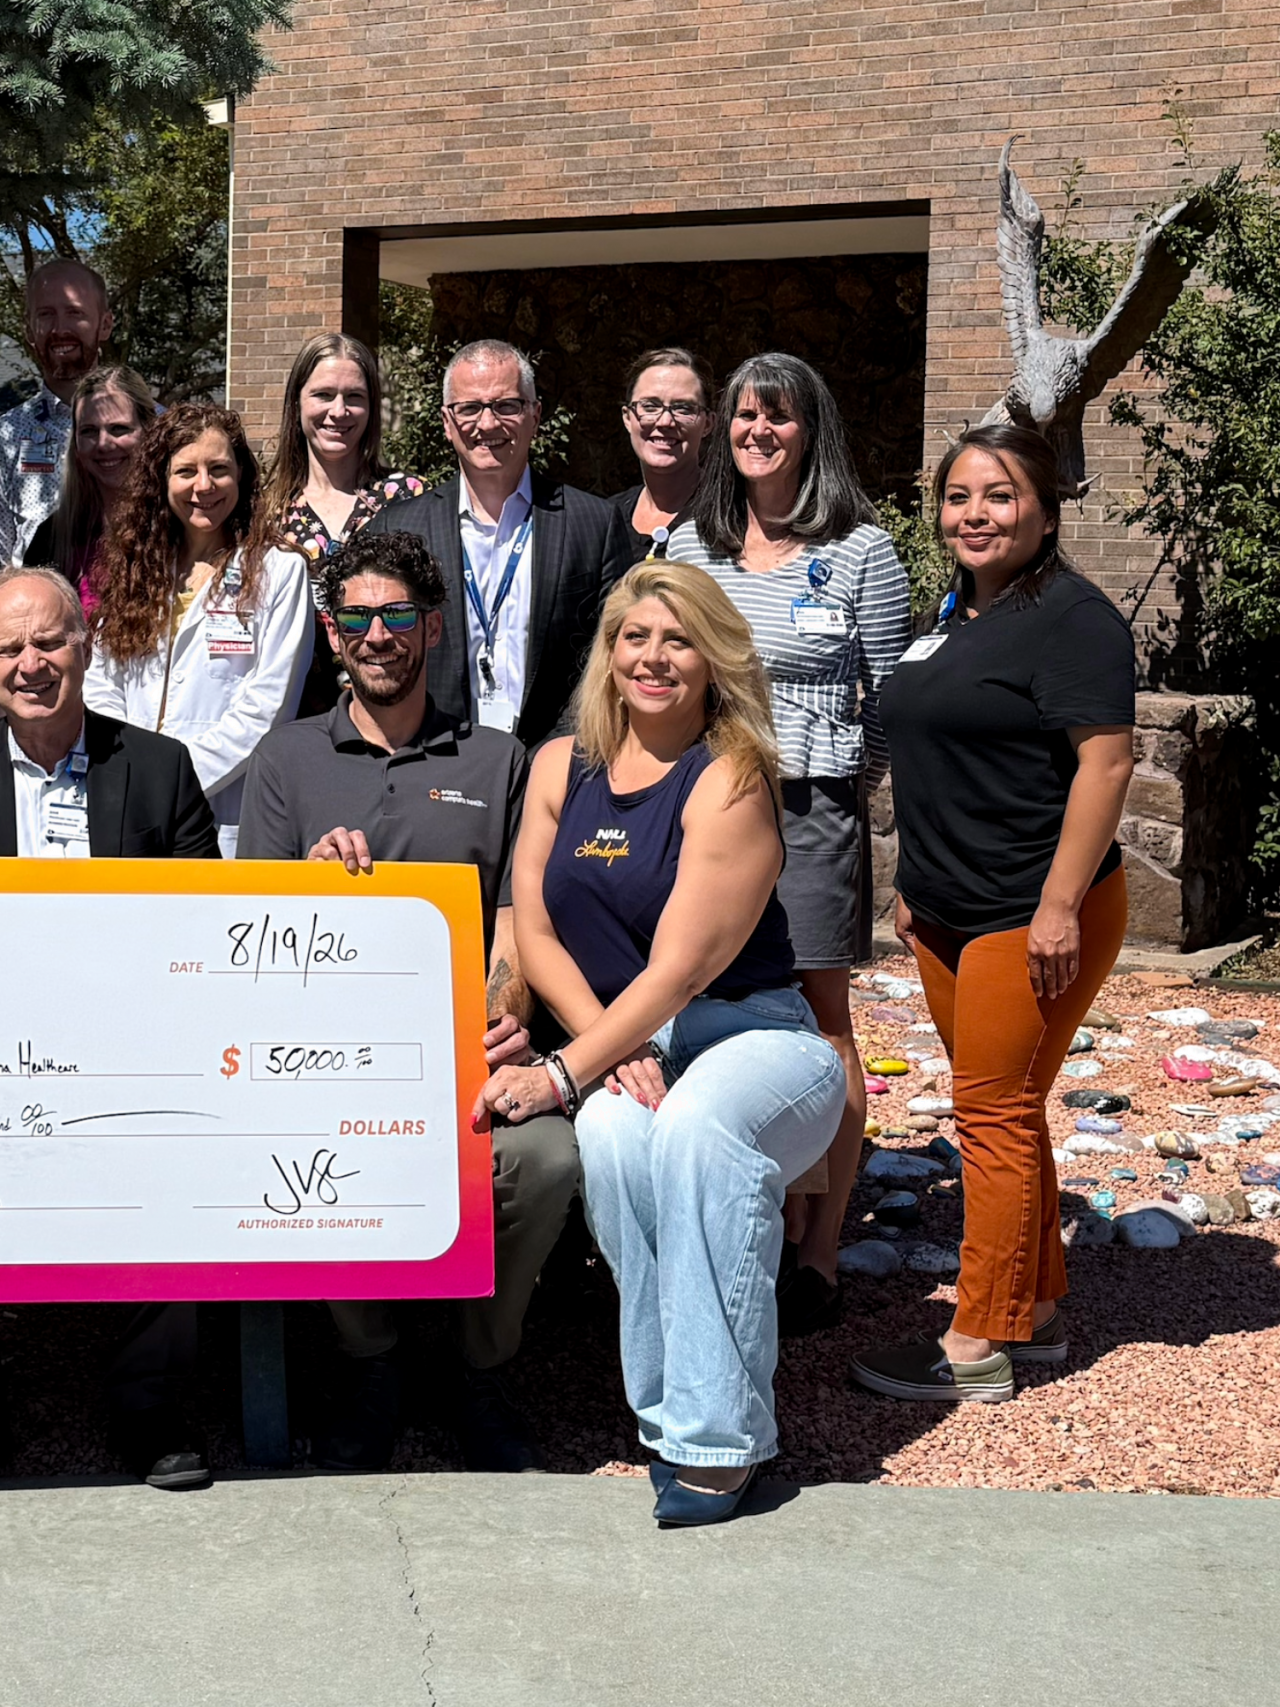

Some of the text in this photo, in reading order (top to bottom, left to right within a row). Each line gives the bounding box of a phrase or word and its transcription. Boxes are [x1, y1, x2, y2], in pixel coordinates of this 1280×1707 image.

[208, 641, 252, 652] Physician
[227, 913, 358, 988] 8/19/26
[169, 961, 204, 973] DATE
[19, 1039, 80, 1078] Healthcare
[220, 1044, 241, 1079] $
[339, 1119, 426, 1136] DOLLARS
[237, 1217, 384, 1229] AUTHORIZED SIGNATURE
